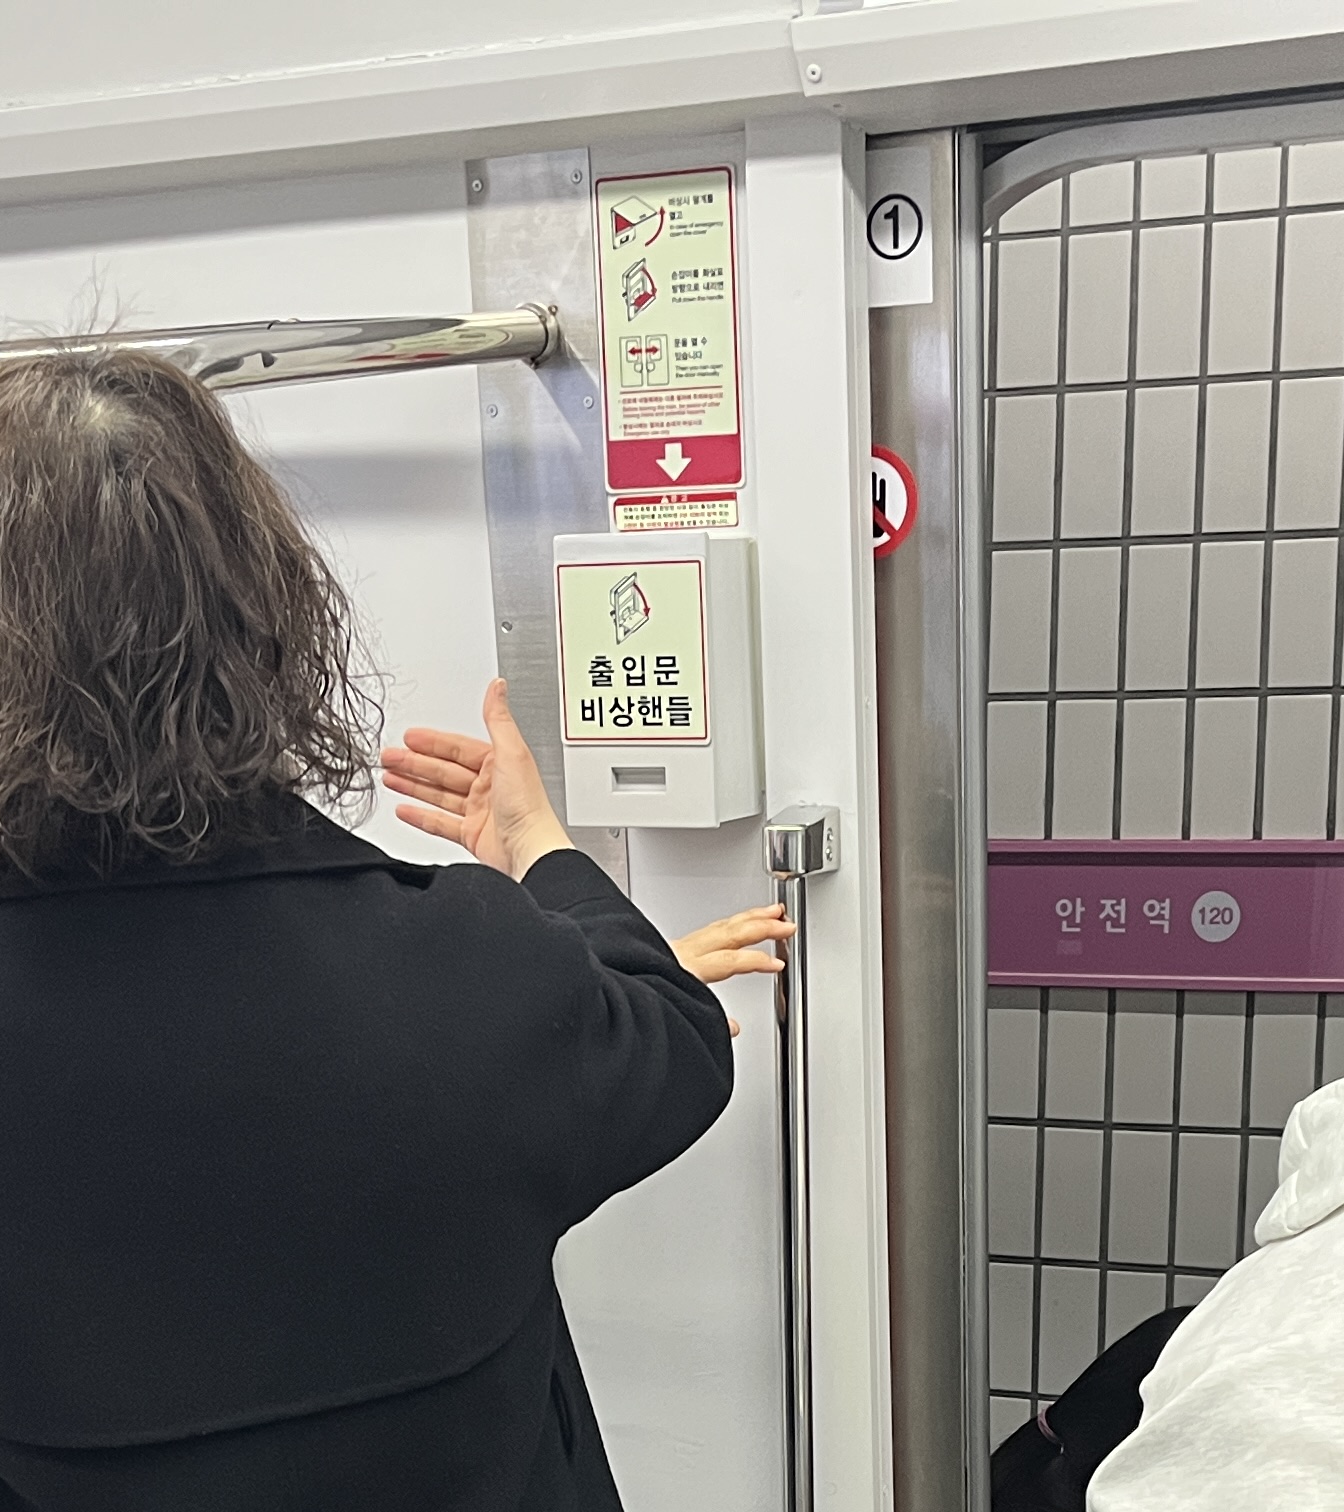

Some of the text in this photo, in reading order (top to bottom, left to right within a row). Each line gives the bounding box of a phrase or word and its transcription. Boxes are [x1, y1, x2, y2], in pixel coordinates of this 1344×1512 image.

[588, 655, 680, 687] 출입문
[580, 695, 693, 727] 비상핸들
[1055, 897, 1234, 934] 안전역 120
